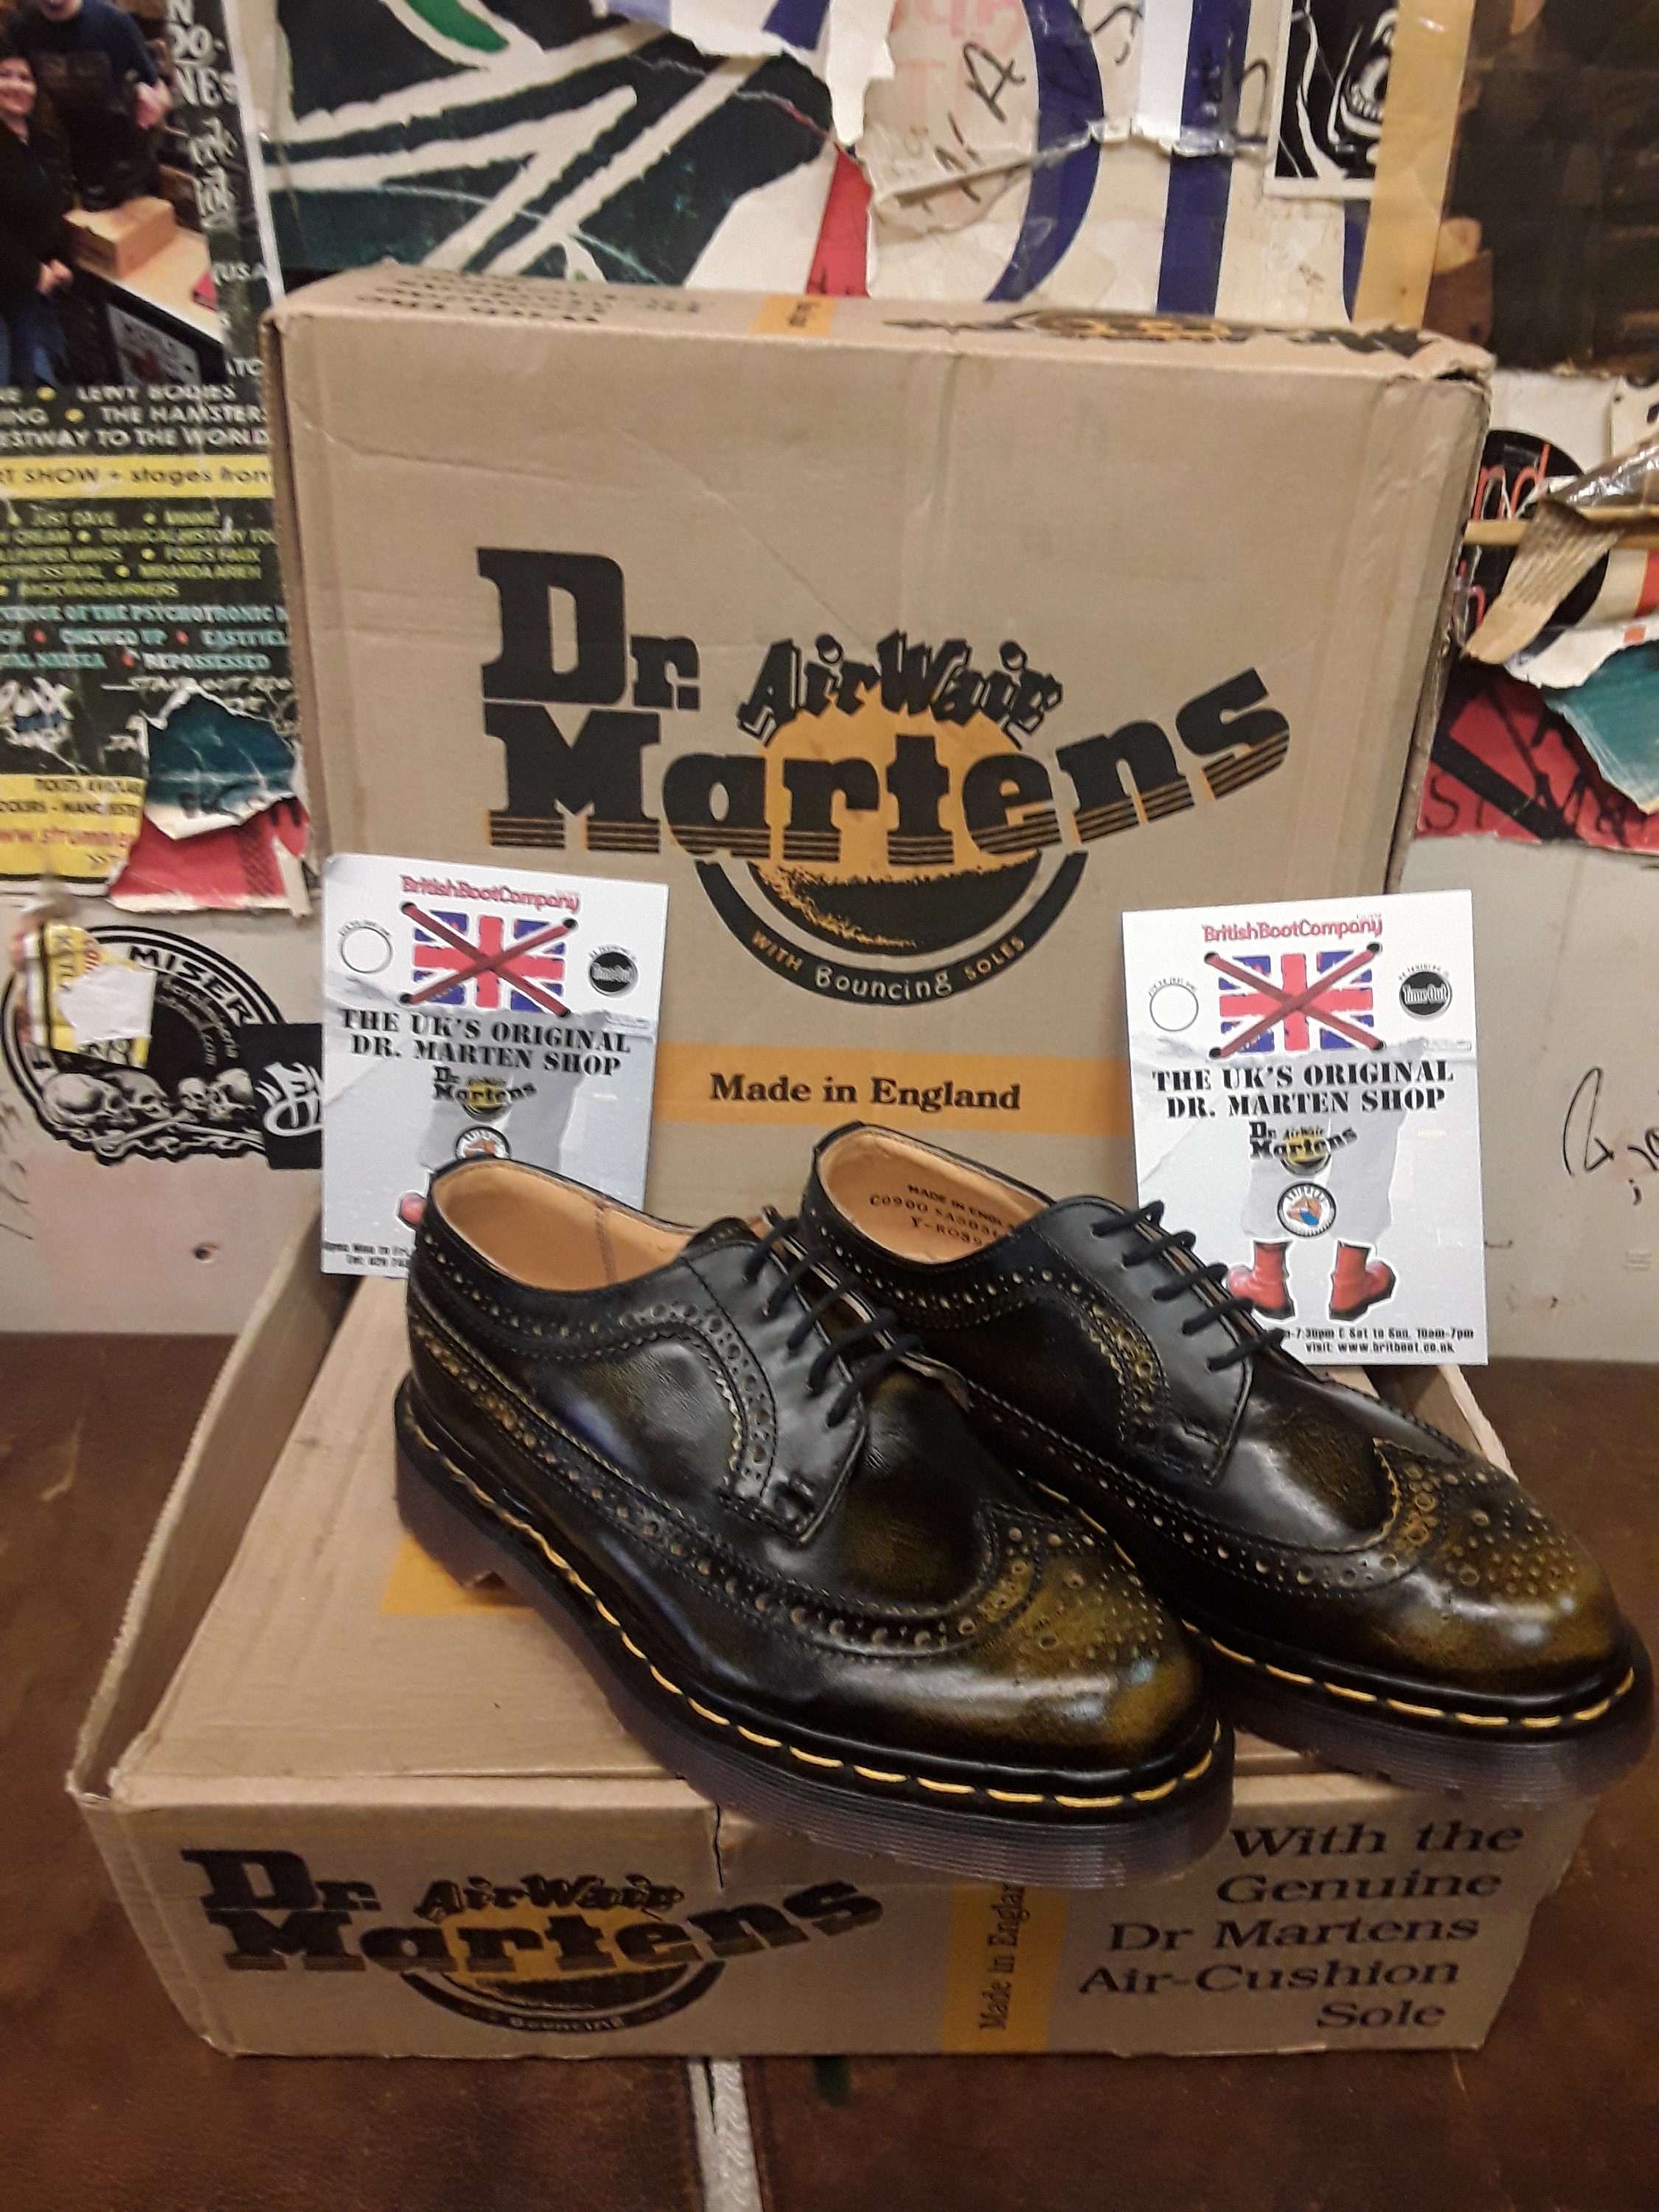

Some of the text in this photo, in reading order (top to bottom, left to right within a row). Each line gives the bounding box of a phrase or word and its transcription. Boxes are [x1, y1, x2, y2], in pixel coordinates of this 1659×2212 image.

[476, 546, 700, 710] Dr.
[484, 667, 1290, 869] Martens
[1203, 917, 1383, 942] BritishBootCompany
[751, 929, 1026, 1002] WITH Bouncing SOLES
[340, 1008, 632, 1054] THE UK'S ORIGINAL
[350, 1034, 622, 1077] DR. MARTEN SHOP
[709, 1071, 1022, 1113] Made in England
[1152, 1060, 1453, 1092] THE UK'S ORIGINAL
[1166, 1088, 1445, 1118] DR. MARTEN SHOP
[1230, 1820, 1523, 1859] With the
[180, 1849, 381, 1911] Dr.
[1217, 1869, 1502, 1905] Genuine
[206, 1879, 883, 1973] Martens
[1109, 1917, 1479, 1951] Dr Martens
[1078, 1960, 1460, 1995] Air-Cushion
[1317, 2000, 1447, 2029] Sole
